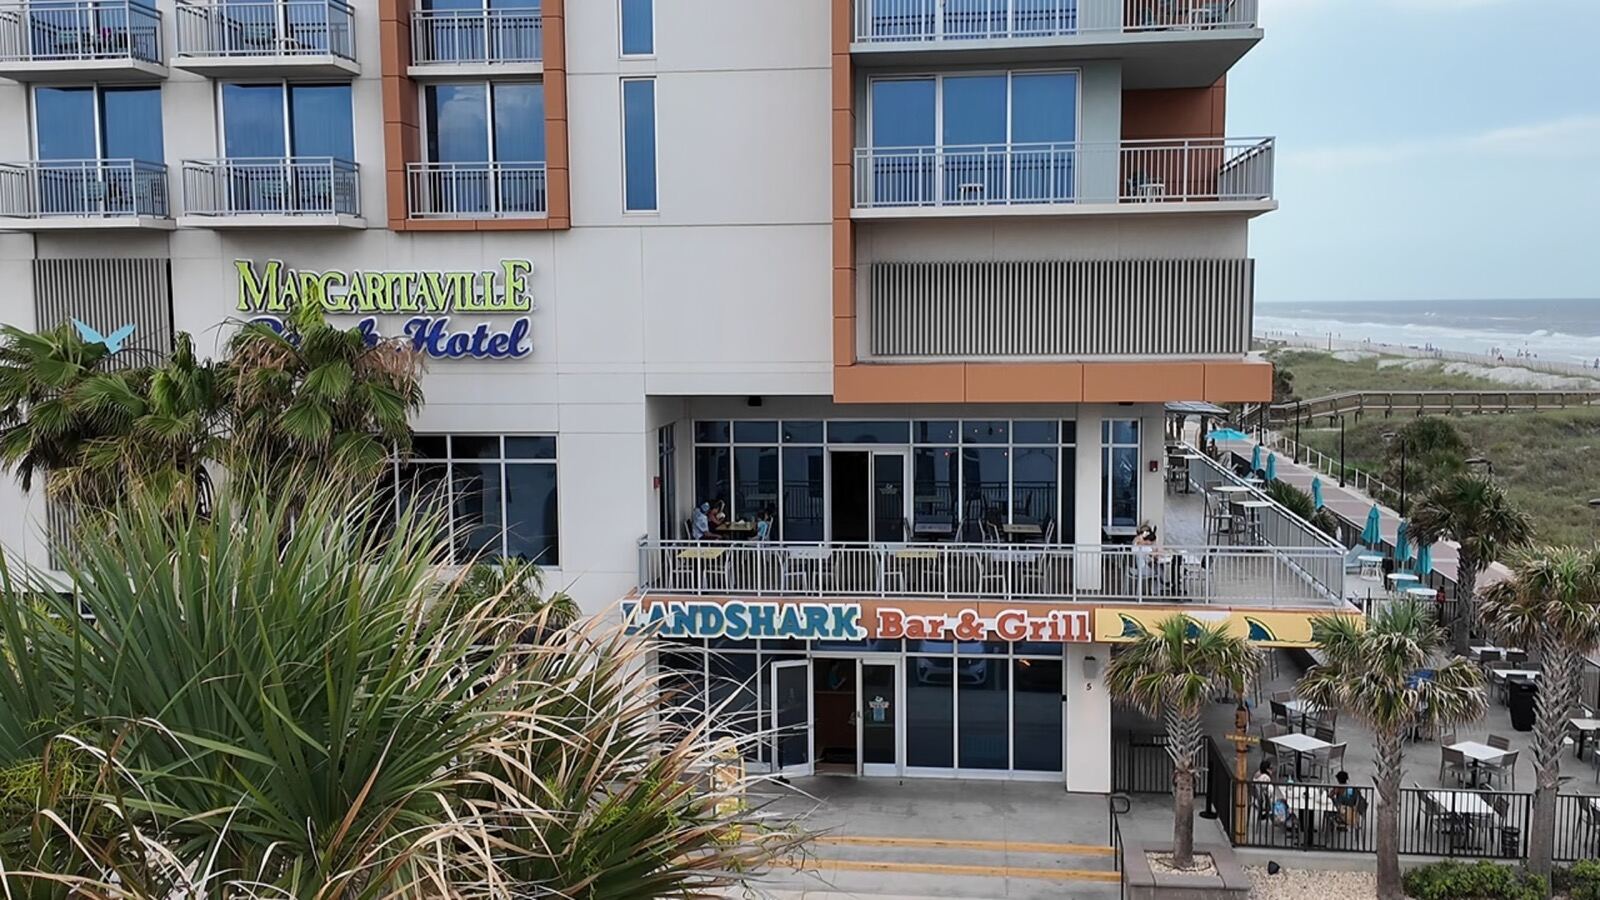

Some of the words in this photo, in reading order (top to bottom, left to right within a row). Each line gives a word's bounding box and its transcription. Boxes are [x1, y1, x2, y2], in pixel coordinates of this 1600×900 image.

[404, 317, 530, 358] Hotel
[878, 610, 944, 638] Bar
[955, 611, 985, 640] &
[997, 612, 1090, 641] Grill
